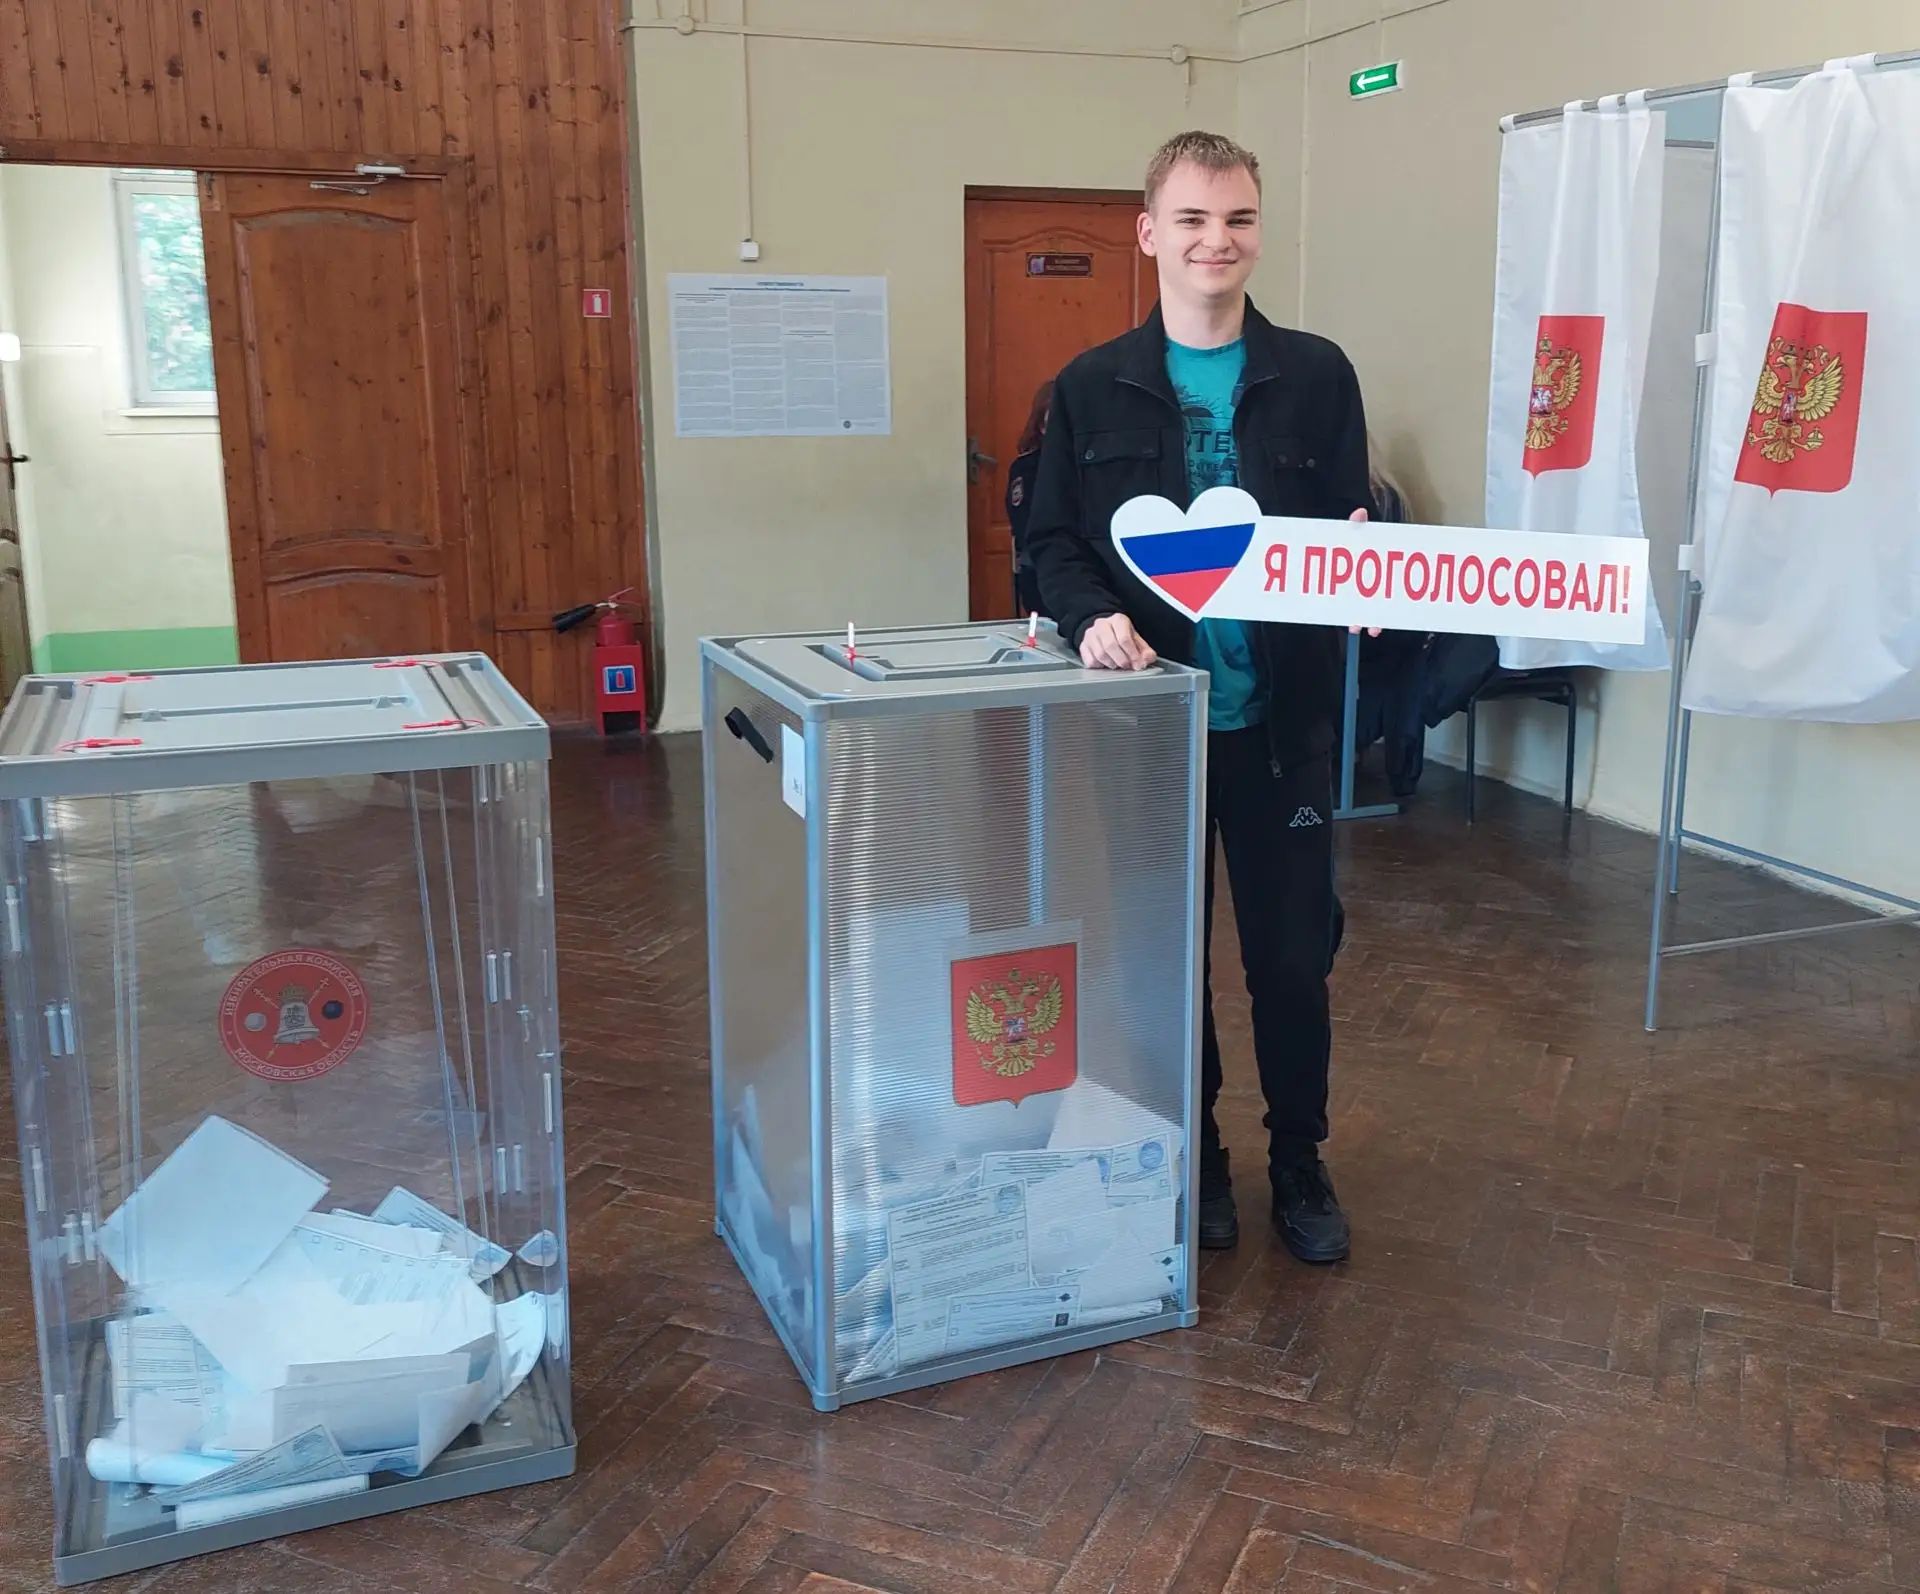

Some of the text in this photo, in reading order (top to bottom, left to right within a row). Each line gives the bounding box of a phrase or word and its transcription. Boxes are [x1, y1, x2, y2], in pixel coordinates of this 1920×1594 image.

[1264, 543, 1632, 614] Я ПРОГОЛОСОВАЛ!
[223, 953, 361, 1016] ИЗБИРАТЕЛЬНАЯ КОМИССИЯ
[234, 1030, 361, 1078] МОСКОВСКАЯ ОБЛАСТЬ
